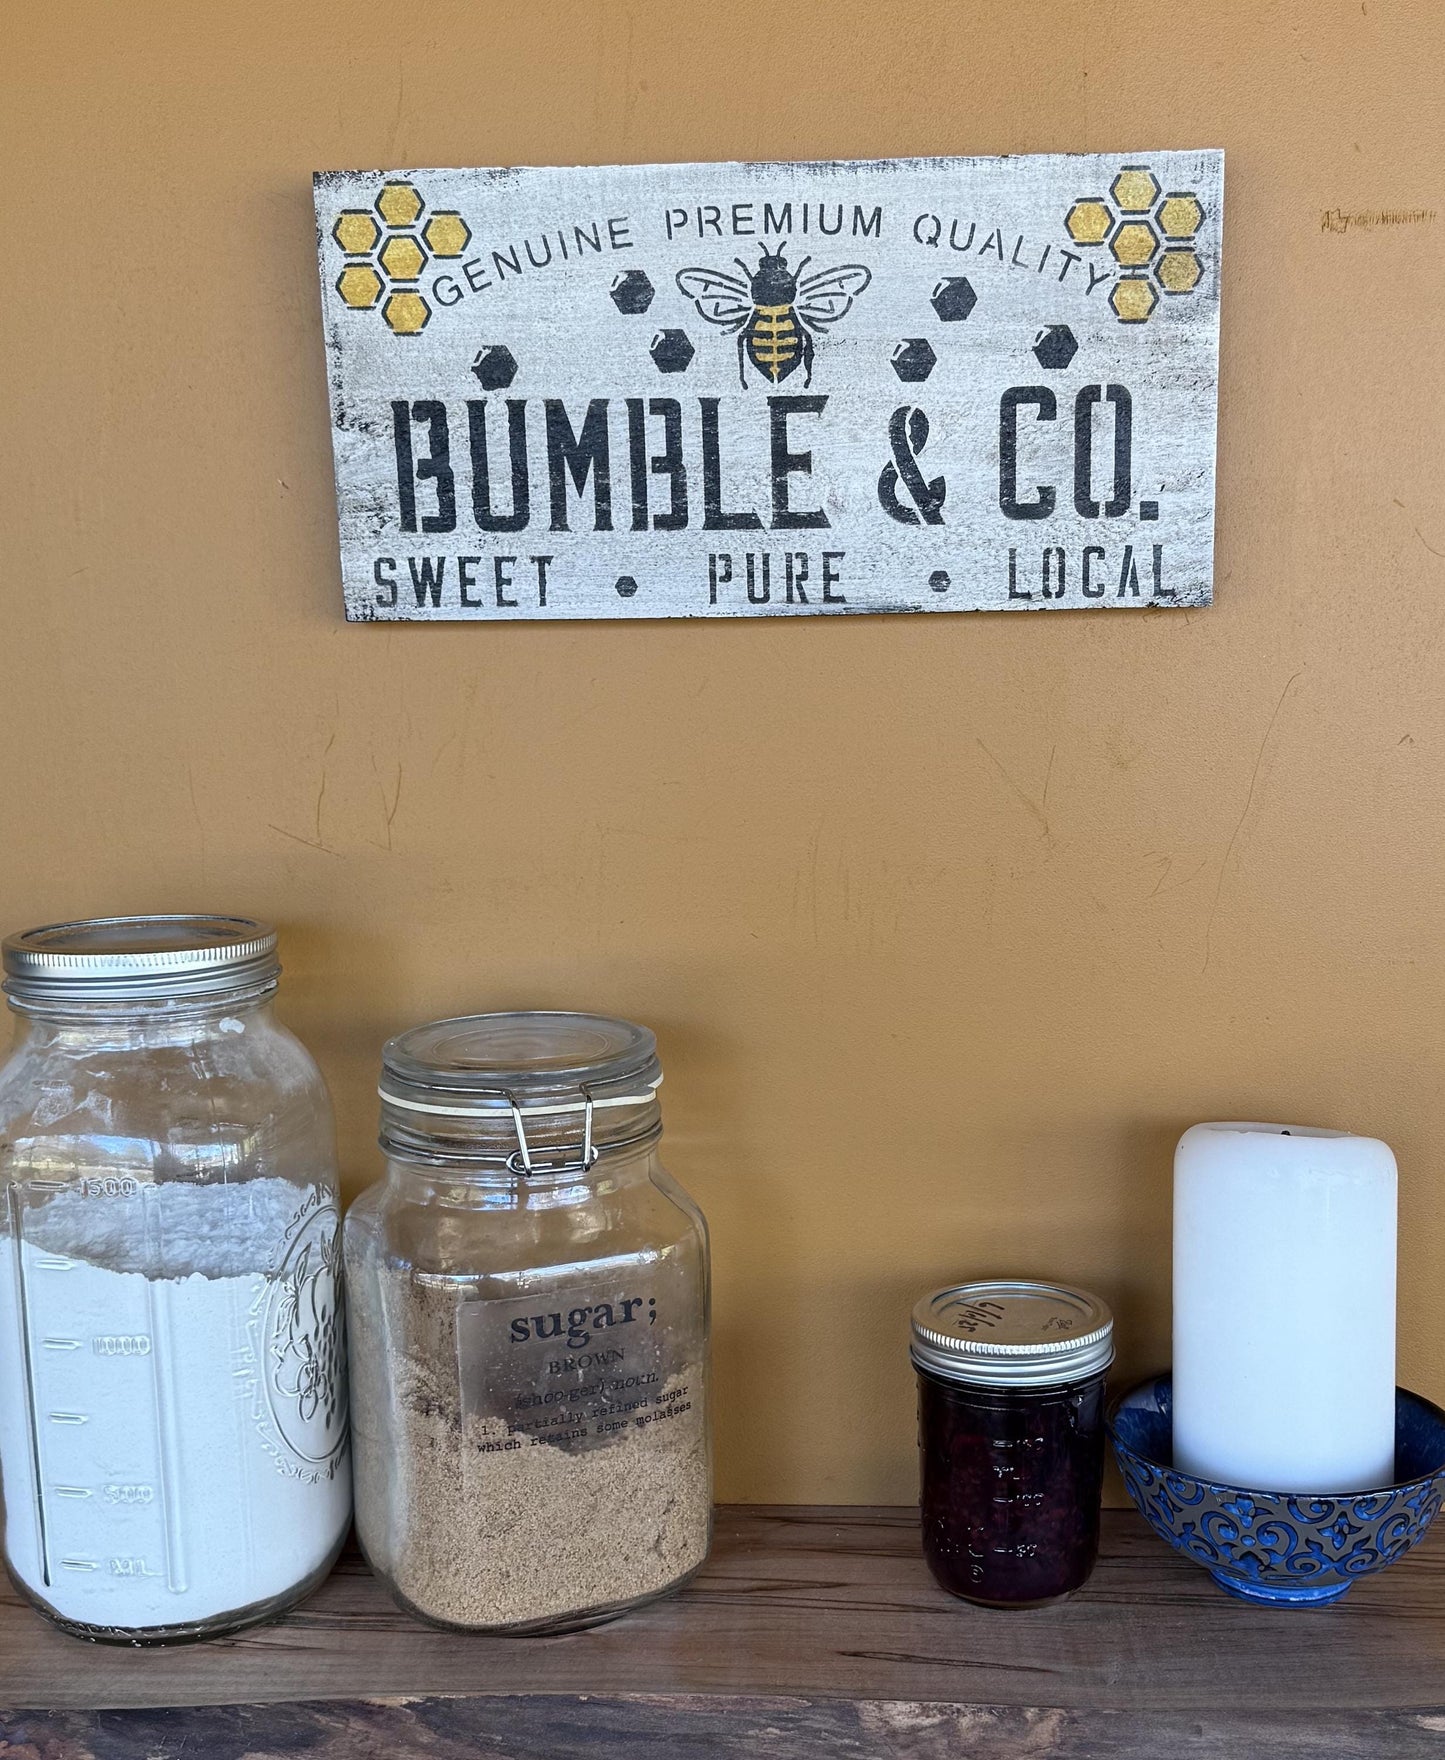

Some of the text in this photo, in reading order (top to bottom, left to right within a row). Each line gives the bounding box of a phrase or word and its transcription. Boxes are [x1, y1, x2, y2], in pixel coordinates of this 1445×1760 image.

[431, 202, 1114, 307] GENUINE PREMIUM QUALITY
[390, 383, 1159, 533] BUMBLE & CO.
[373, 544, 1176, 608] SWEET PURE LOCAL
[80, 1176, 139, 1199] 1500
[510, 1296, 657, 1349] sugar;
[549, 1347, 626, 1375] BROWN
[477, 1400, 692, 1453] which retains some molasses
[481, 1385, 689, 1437] 1. partially refined sugar
